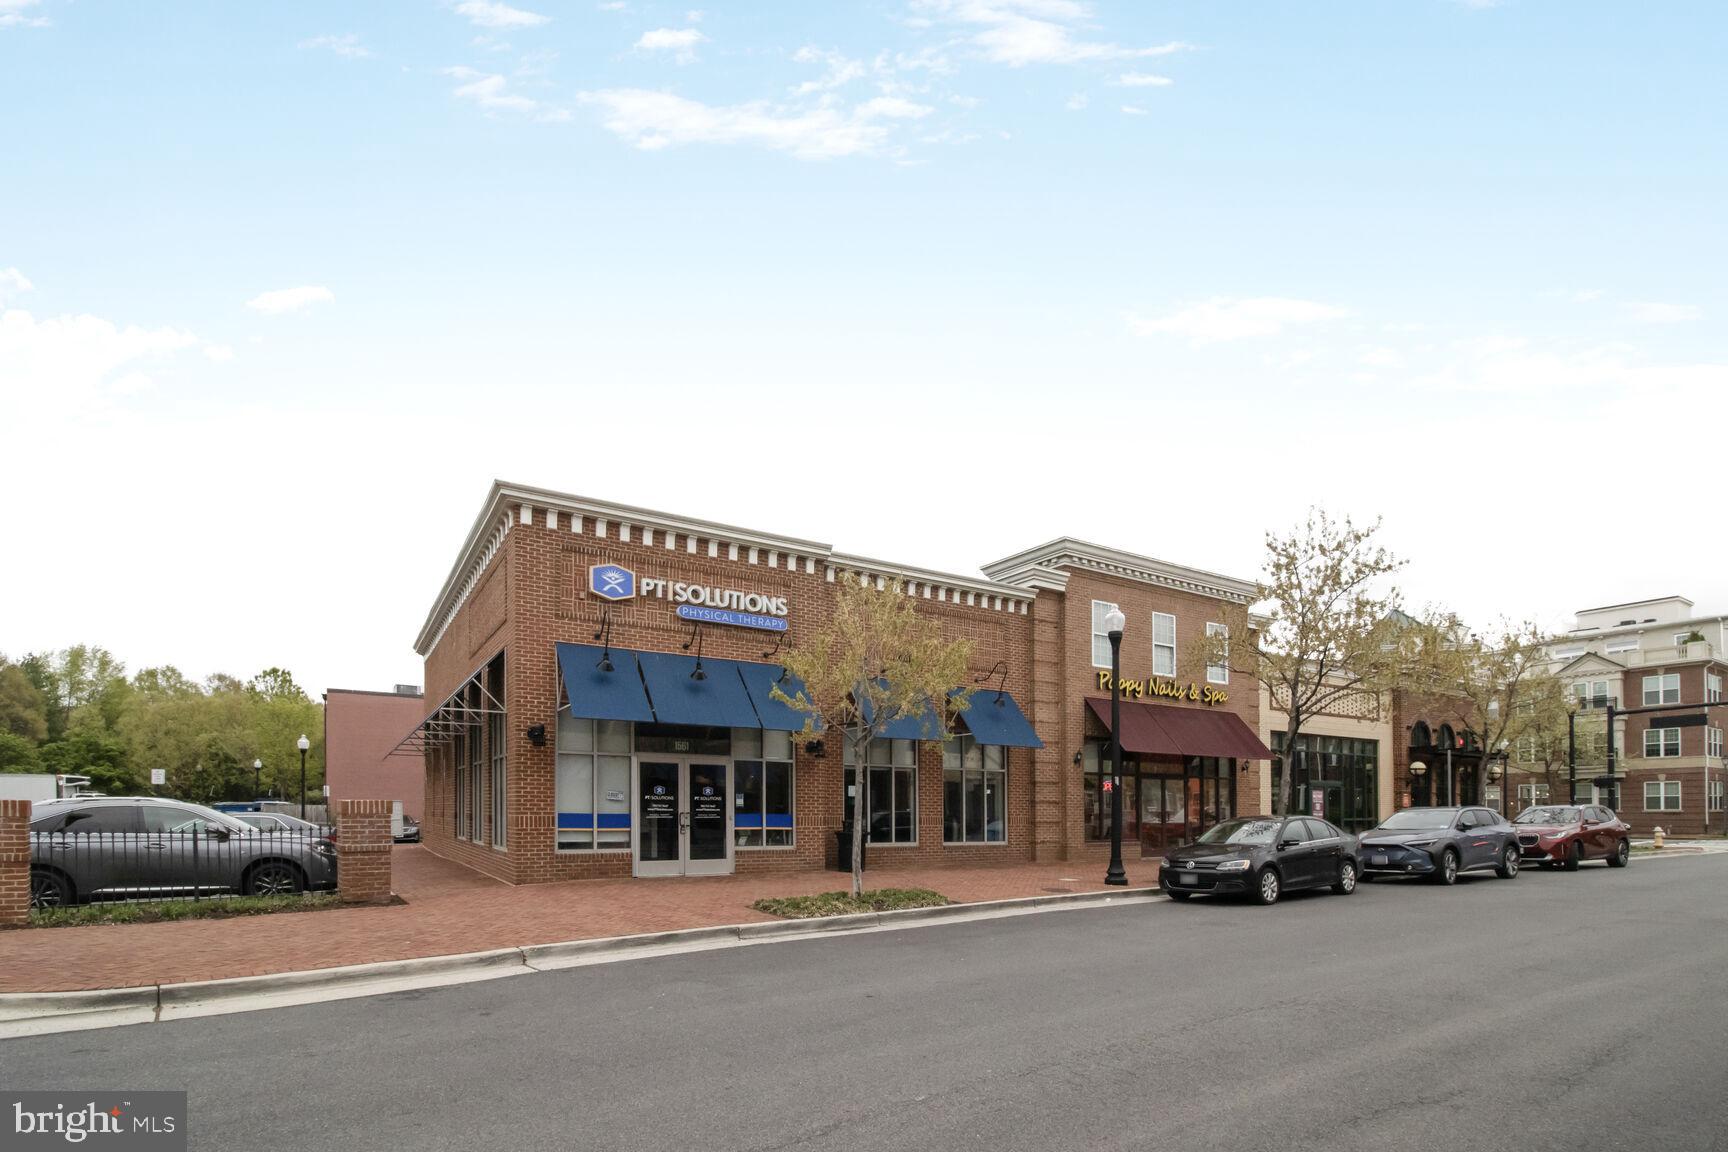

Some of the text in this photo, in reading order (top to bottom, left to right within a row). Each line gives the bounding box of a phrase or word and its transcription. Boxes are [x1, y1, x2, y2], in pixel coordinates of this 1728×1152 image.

[673, 582, 788, 616] SOLUTIONS
[682, 606, 785, 630] PHYSICAL THERAPY
[1149, 676, 1187, 699] Nails
[1189, 682, 1200, 700] &
[1203, 684, 1229, 706] Spa
